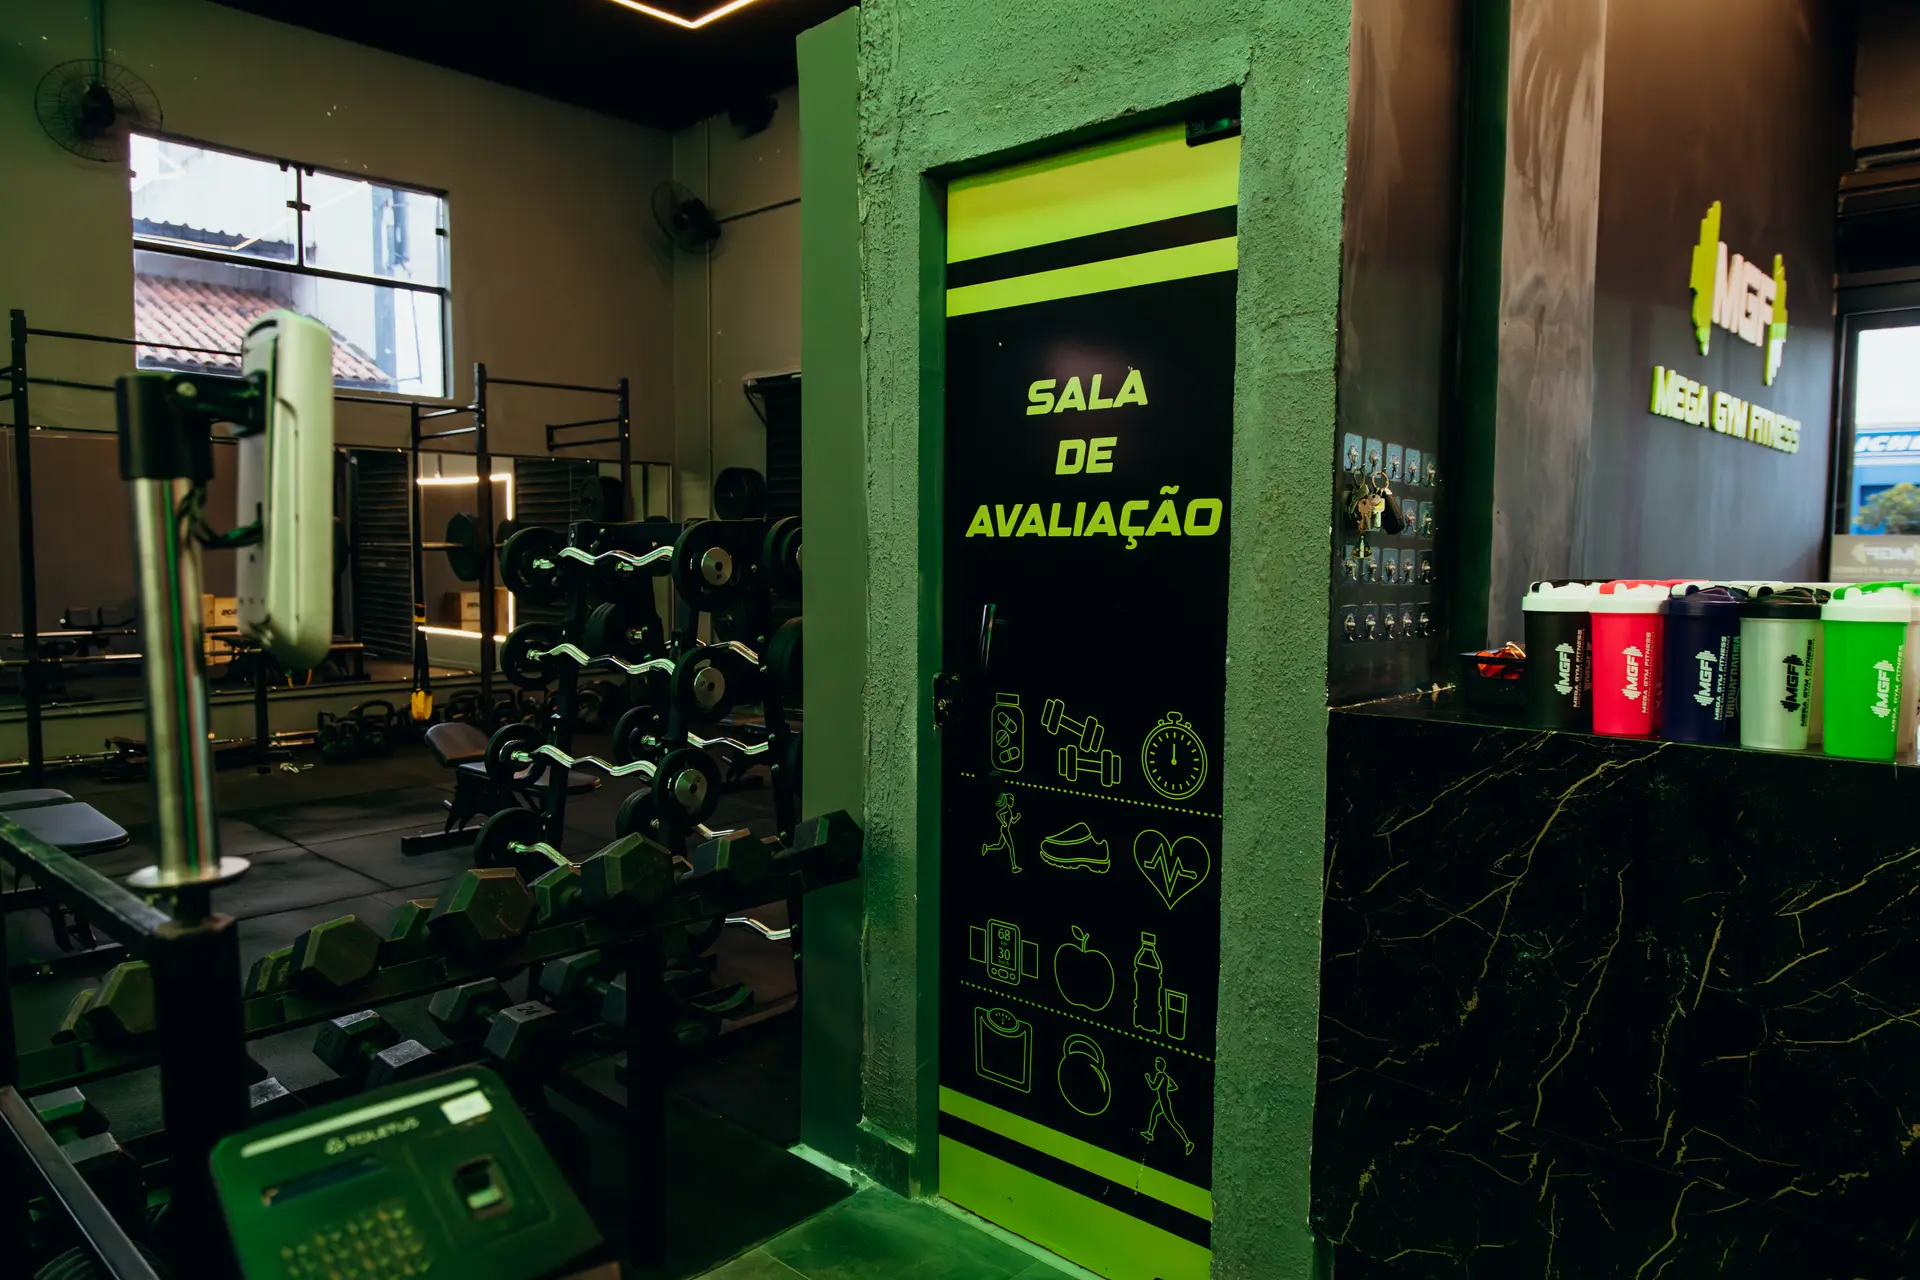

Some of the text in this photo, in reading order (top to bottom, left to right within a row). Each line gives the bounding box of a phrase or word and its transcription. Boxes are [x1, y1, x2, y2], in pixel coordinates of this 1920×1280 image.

[1711, 240, 1777, 347] MGF
[1026, 369, 1148, 415] SALA
[1649, 365, 1801, 454] MEGA GYM FITNESS
[1055, 436, 1118, 475] DE
[965, 485, 1223, 550] AVALIAÇÃO
[1559, 651, 1571, 686] MGF
[1626, 654, 1639, 691] MGF
[1698, 659, 1712, 697] MGF
[1714, 696, 1722, 720] MEGA
[1719, 636, 1727, 672] FITNESS
[1785, 664, 1799, 702] MGF
[1800, 701, 1808, 727] MEGA
[1805, 639, 1813, 676] FITNESS
[1876, 669, 1890, 708] MGF
[997, 947, 1010, 960] 30
[998, 928, 1010, 941] 68
